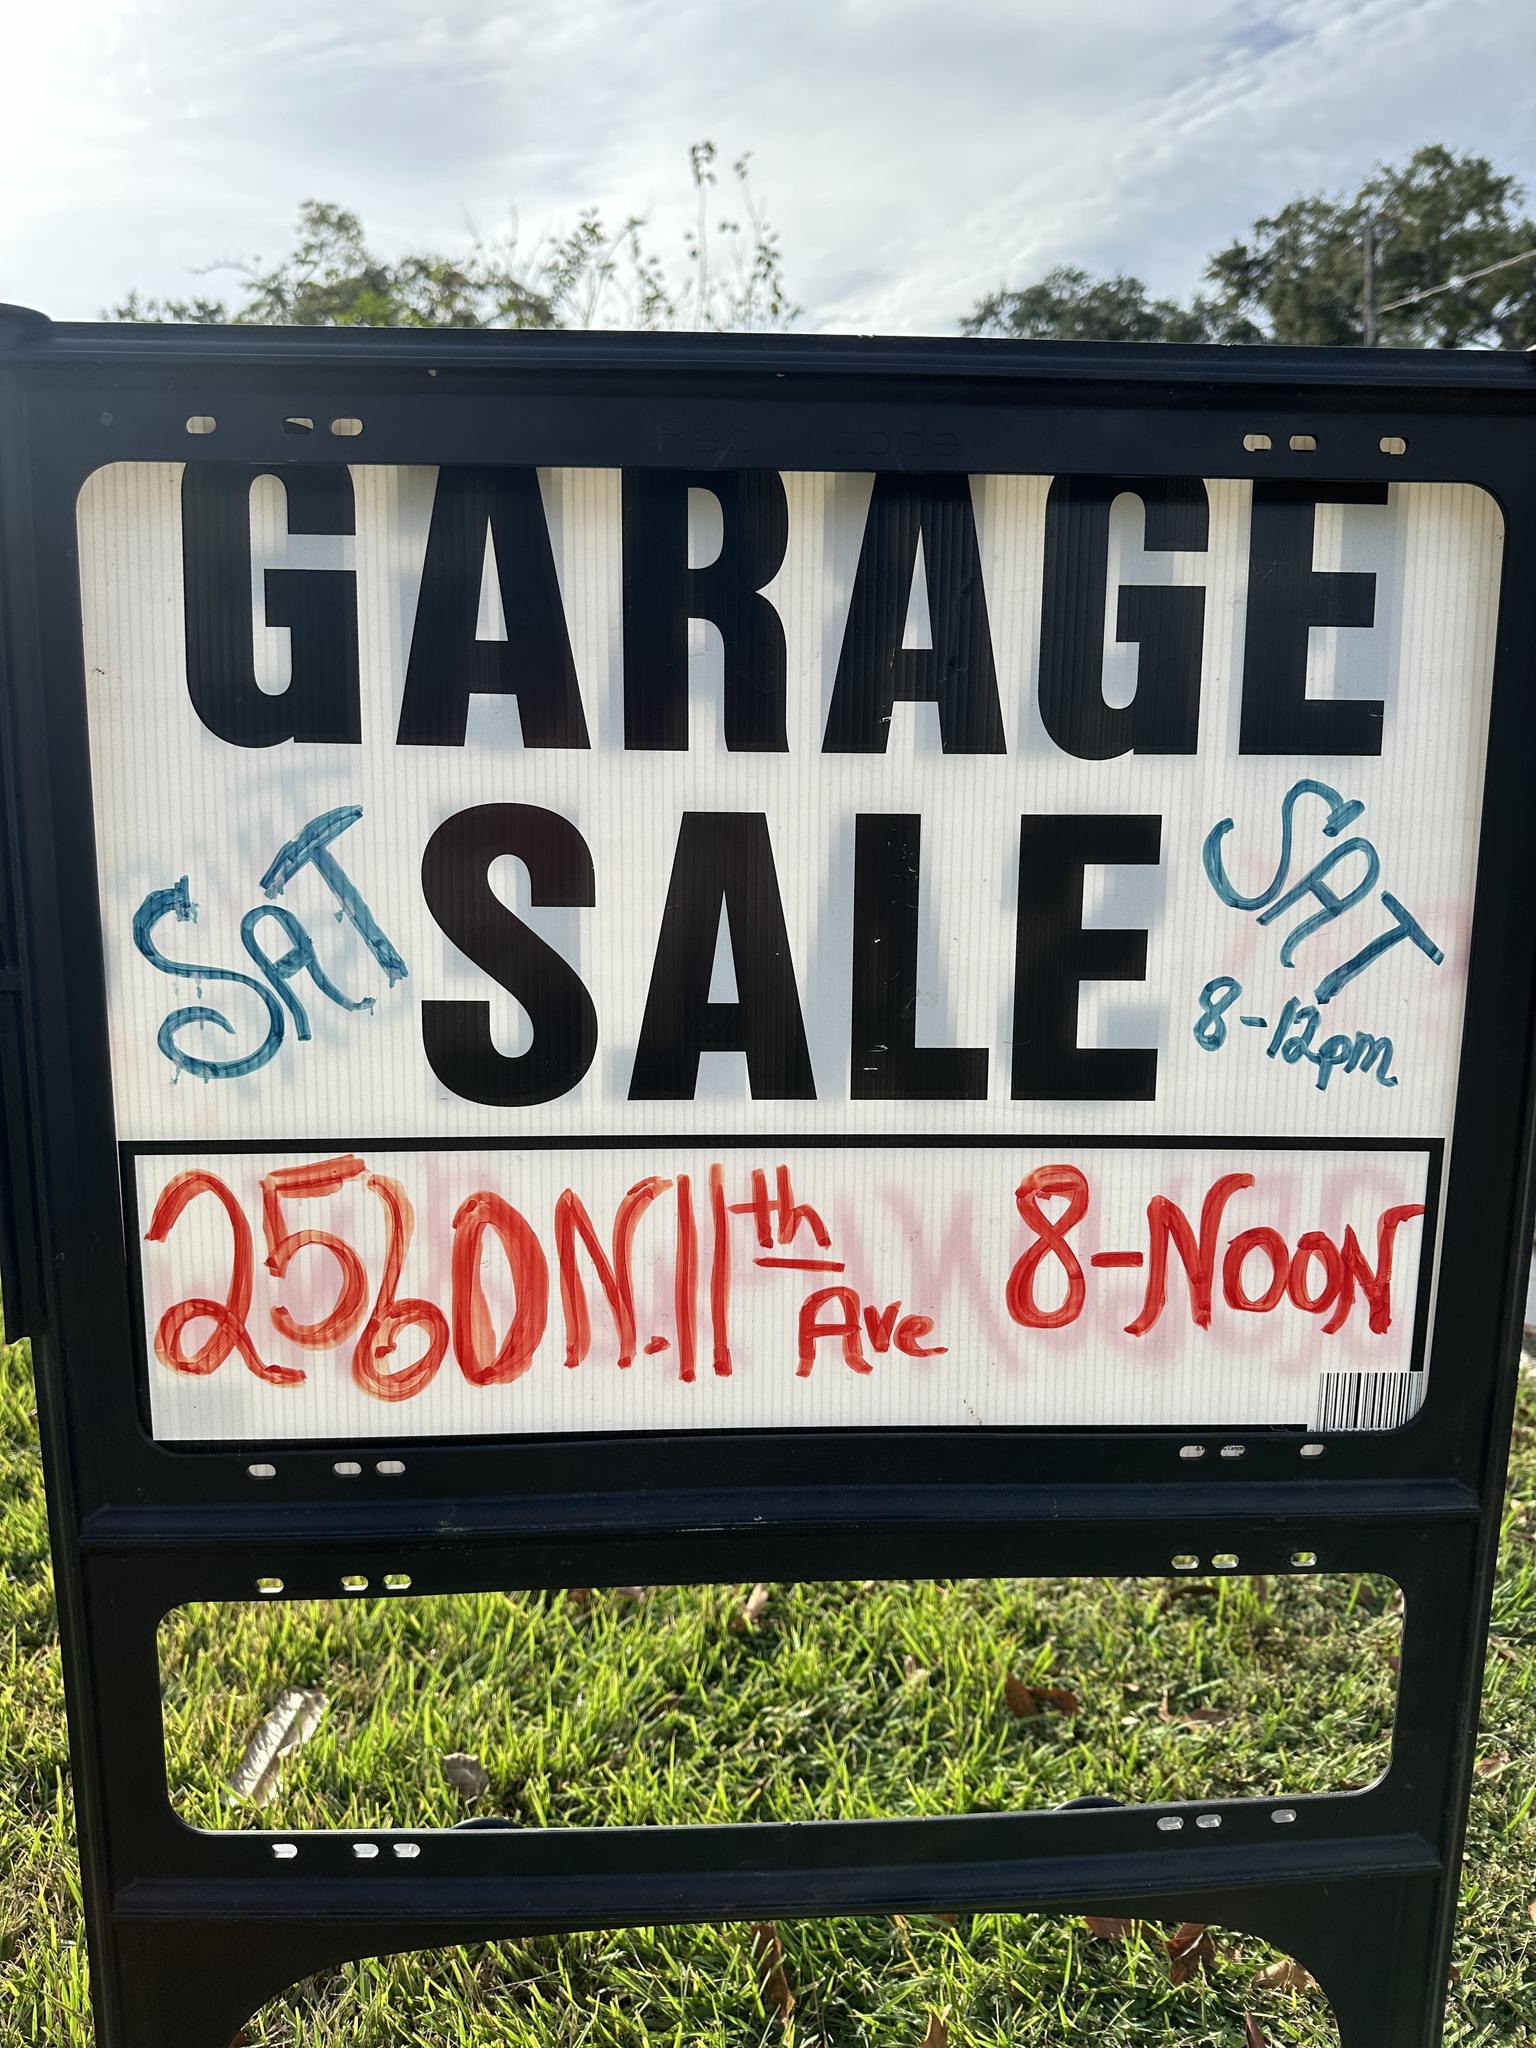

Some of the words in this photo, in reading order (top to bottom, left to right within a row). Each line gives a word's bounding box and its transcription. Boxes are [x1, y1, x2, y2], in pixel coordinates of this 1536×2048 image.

[181, 462, 1390, 761] GARAGE
[133, 805, 408, 1084] SAT
[420, 802, 1162, 1107] SALE
[1202, 779, 1444, 1004] SAT
[144, 1154, 549, 1402] 2560
[795, 1285, 950, 1378] Ave
